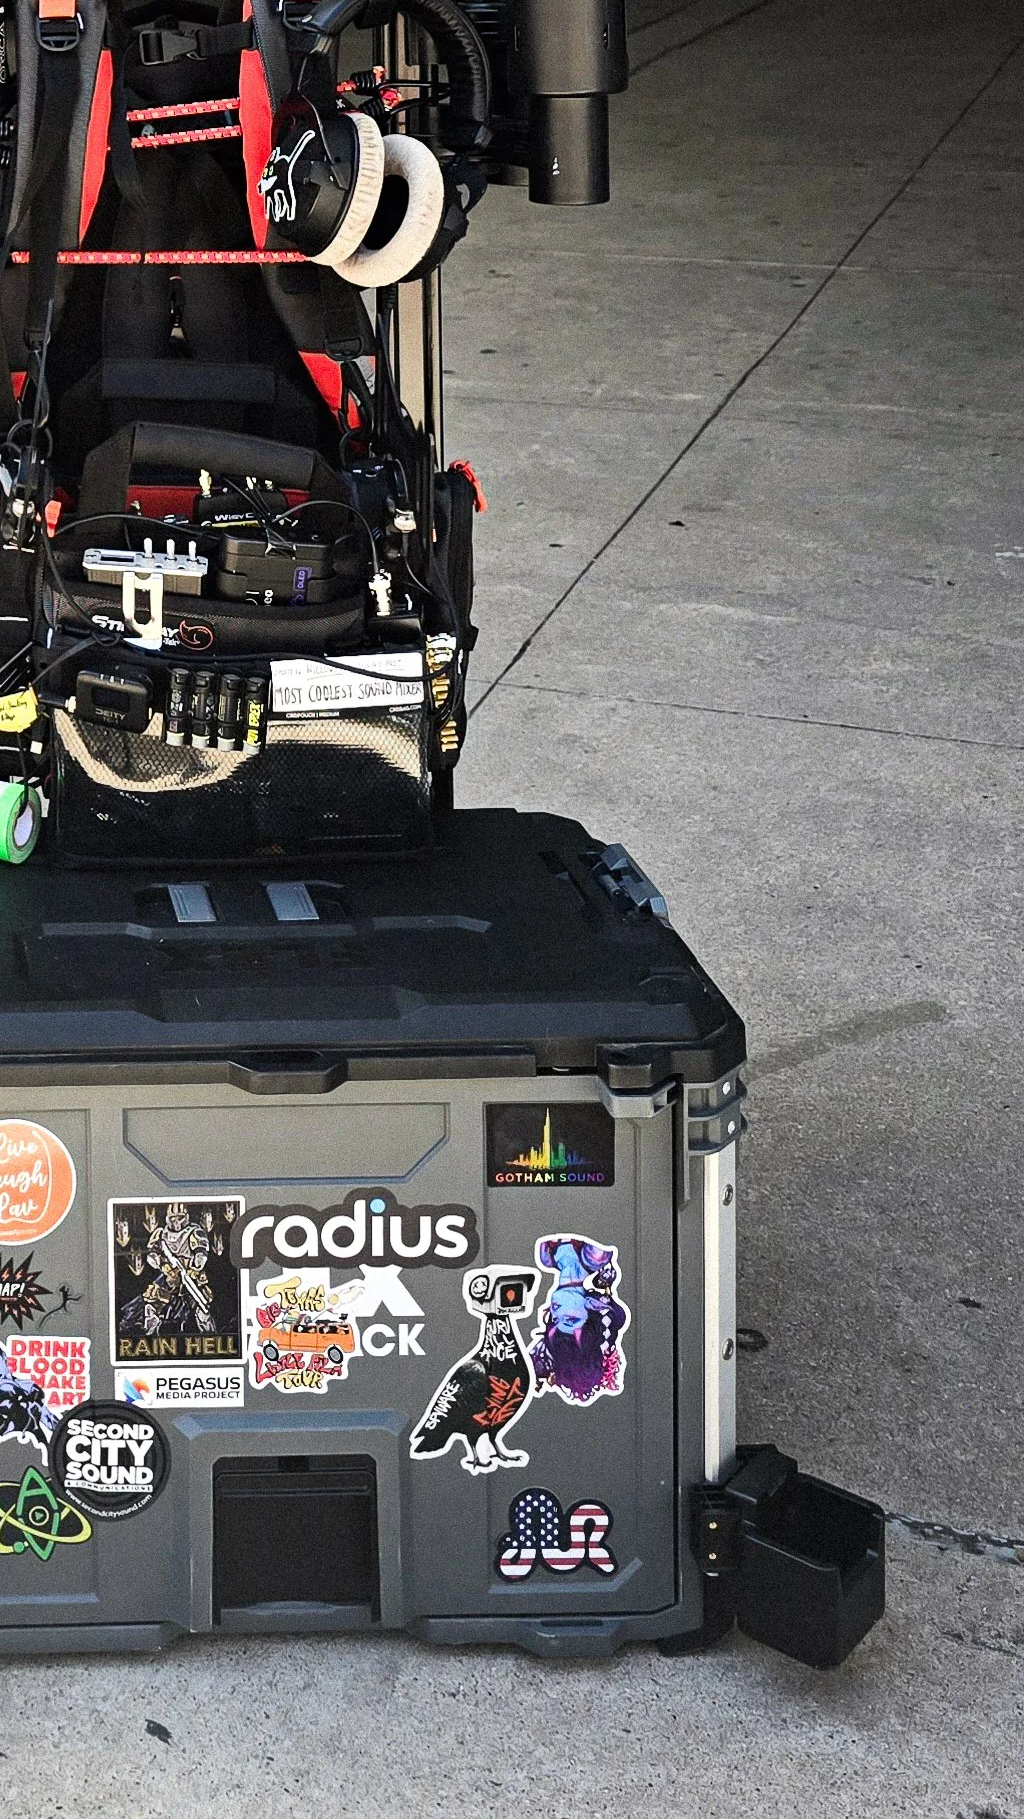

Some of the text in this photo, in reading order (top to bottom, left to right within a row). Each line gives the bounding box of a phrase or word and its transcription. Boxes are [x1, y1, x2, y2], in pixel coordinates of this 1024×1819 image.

[274, 681, 423, 707] MOST COOLEST SOUND MIXER
[95, 708, 126, 721] DEITY
[495, 1172, 606, 1183] GOTHAM SOUND
[241, 1198, 469, 1259] radius
[263, 1276, 326, 1312] TEXAS
[11, 1340, 86, 1358] DRINK
[119, 1335, 239, 1357] RAIN HELL
[361, 1323, 427, 1357] CK
[6, 1356, 85, 1375] BLOOD
[30, 1374, 86, 1390] MAKE
[156, 1376, 241, 1391] PEGASUS
[275, 1369, 325, 1390] TOUR
[47, 1391, 86, 1405] ART
[156, 1390, 241, 1400] MEDIA PROJECT
[425, 1379, 461, 1430] SPYWARE
[67, 1418, 155, 1441] SECOND
[65, 1434, 154, 1466] CITY
[65, 1462, 154, 1485] SOUND
[75, 1480, 151, 1492] COMMUNICATIONS
[65, 1488, 153, 1518] www.secondcitysound.com
